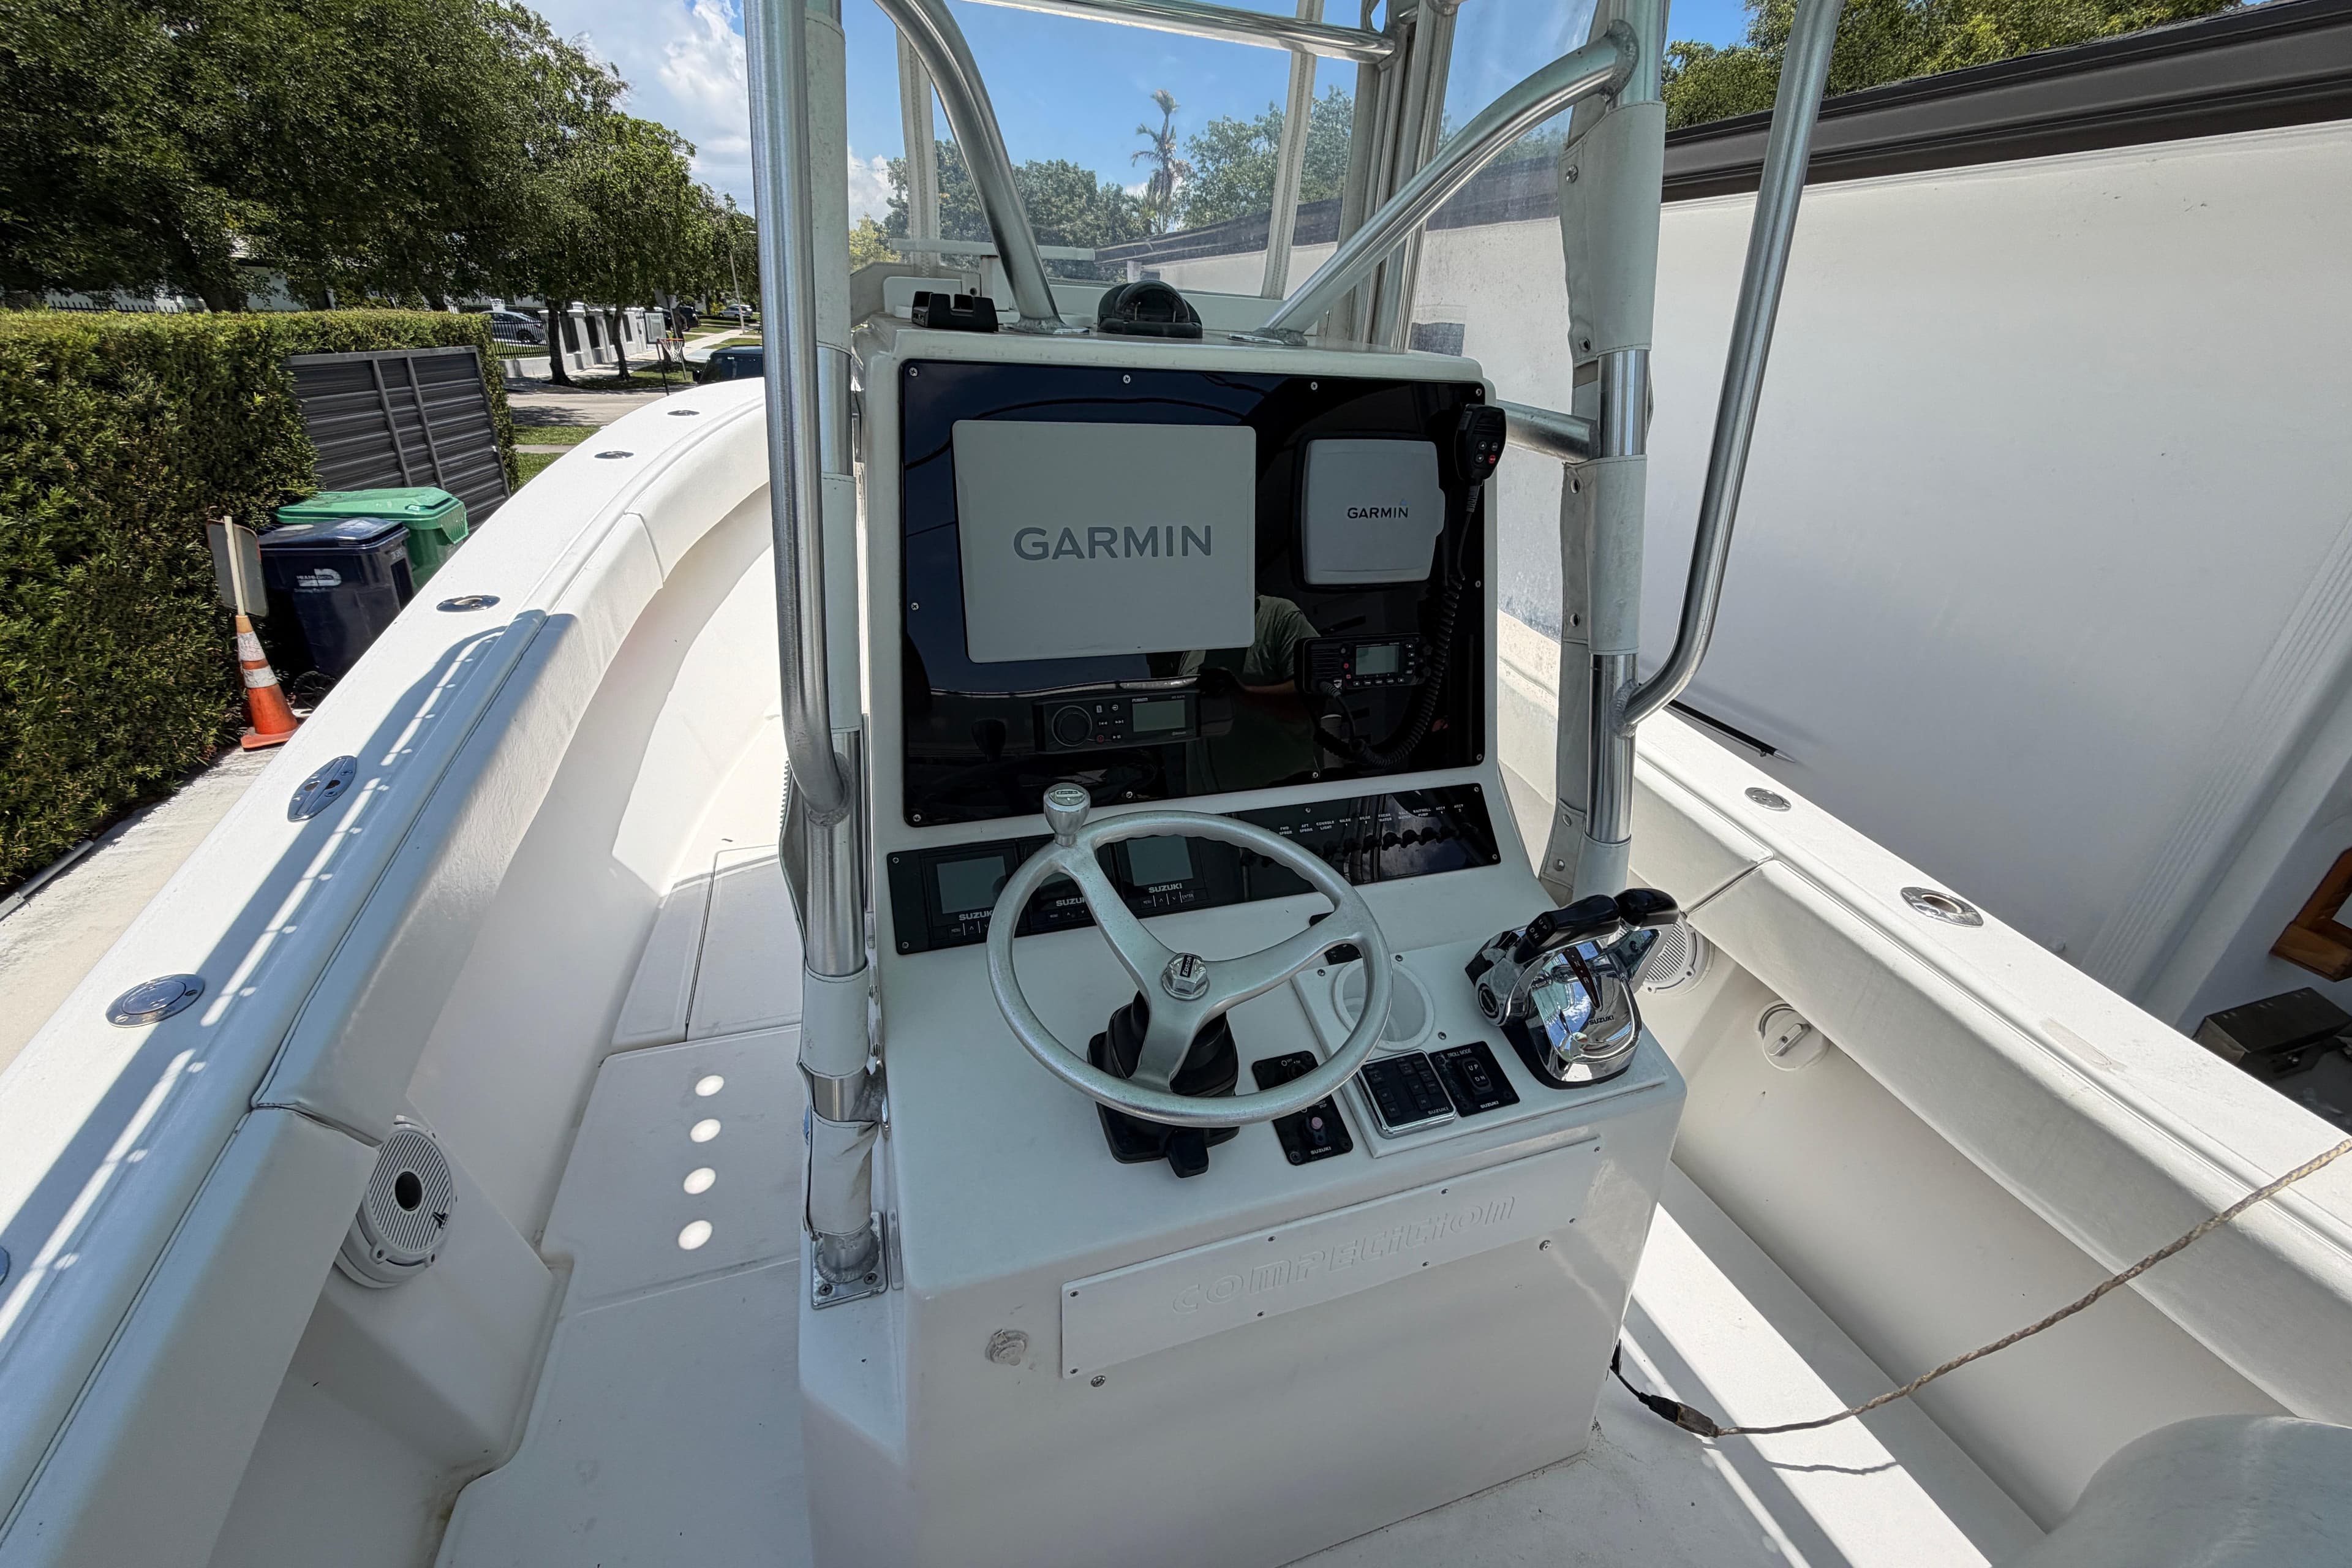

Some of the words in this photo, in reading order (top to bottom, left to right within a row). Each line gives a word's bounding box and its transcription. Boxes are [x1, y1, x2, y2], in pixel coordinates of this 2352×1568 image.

[1347, 507, 1409, 519] GARMIN
[1014, 525, 1212, 560] GARMIN
[1148, 883, 1183, 894] SUZUKI
[1055, 897, 1086, 907] SUZU
[959, 910, 994, 921] SUZUK
[1539, 919, 1547, 929] UP
[1530, 927, 1539, 938] DN
[1588, 1015, 1615, 1026] SUZUKI
[1480, 1100, 1499, 1109] SUZUKI
[1427, 1106, 1449, 1115] SUZUKI
[1310, 1146, 1332, 1155] SUZUKI
